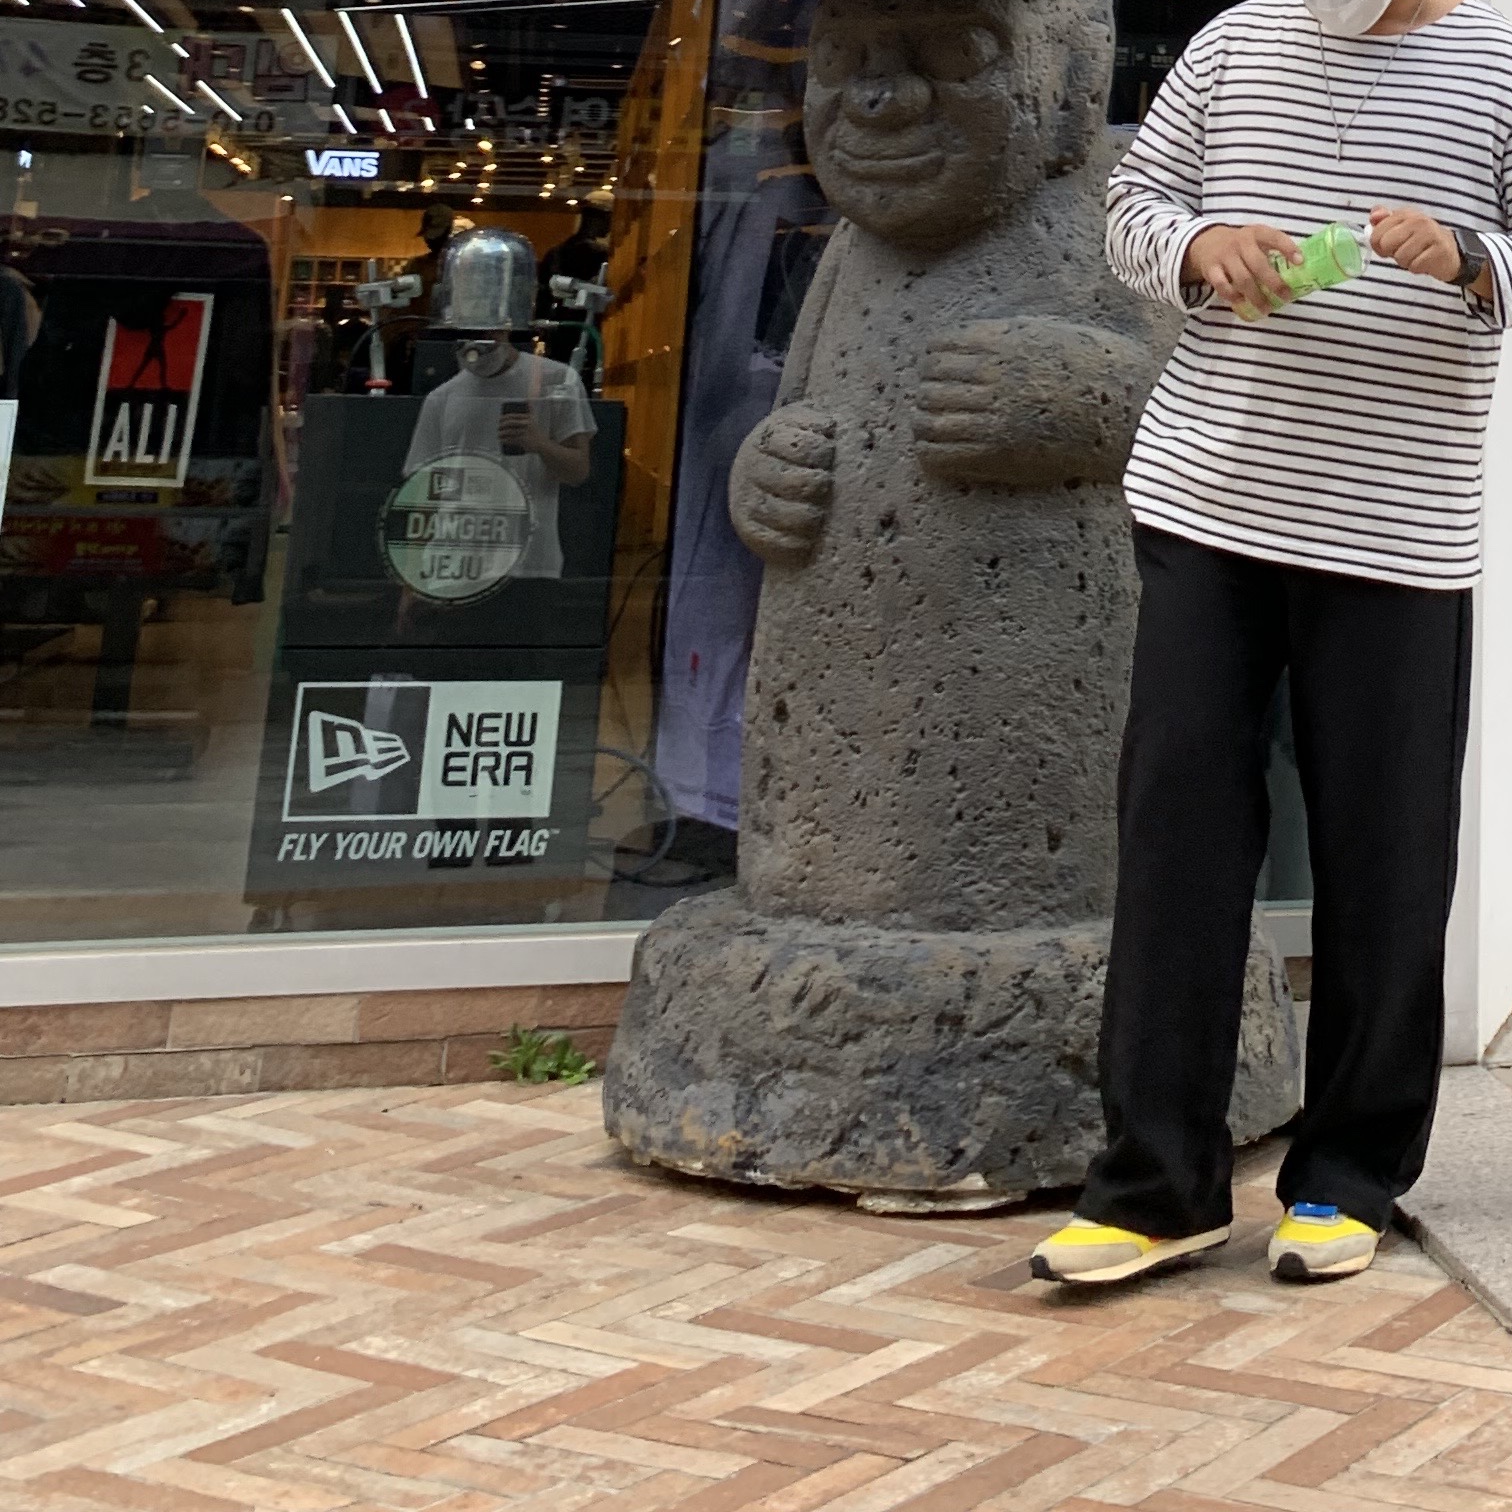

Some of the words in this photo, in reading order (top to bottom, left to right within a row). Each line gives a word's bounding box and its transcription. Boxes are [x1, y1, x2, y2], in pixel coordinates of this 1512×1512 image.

[306, 149, 380, 178] VANS
[104, 403, 179, 464] ALI
[405, 510, 508, 543] DANGER
[419, 554, 483, 580] JEJU
[445, 711, 539, 748] NEW
[441, 750, 534, 787] ERA
[277, 829, 329, 862] FLY
[334, 829, 408, 860] YOUR
[412, 829, 482, 859] OWN
